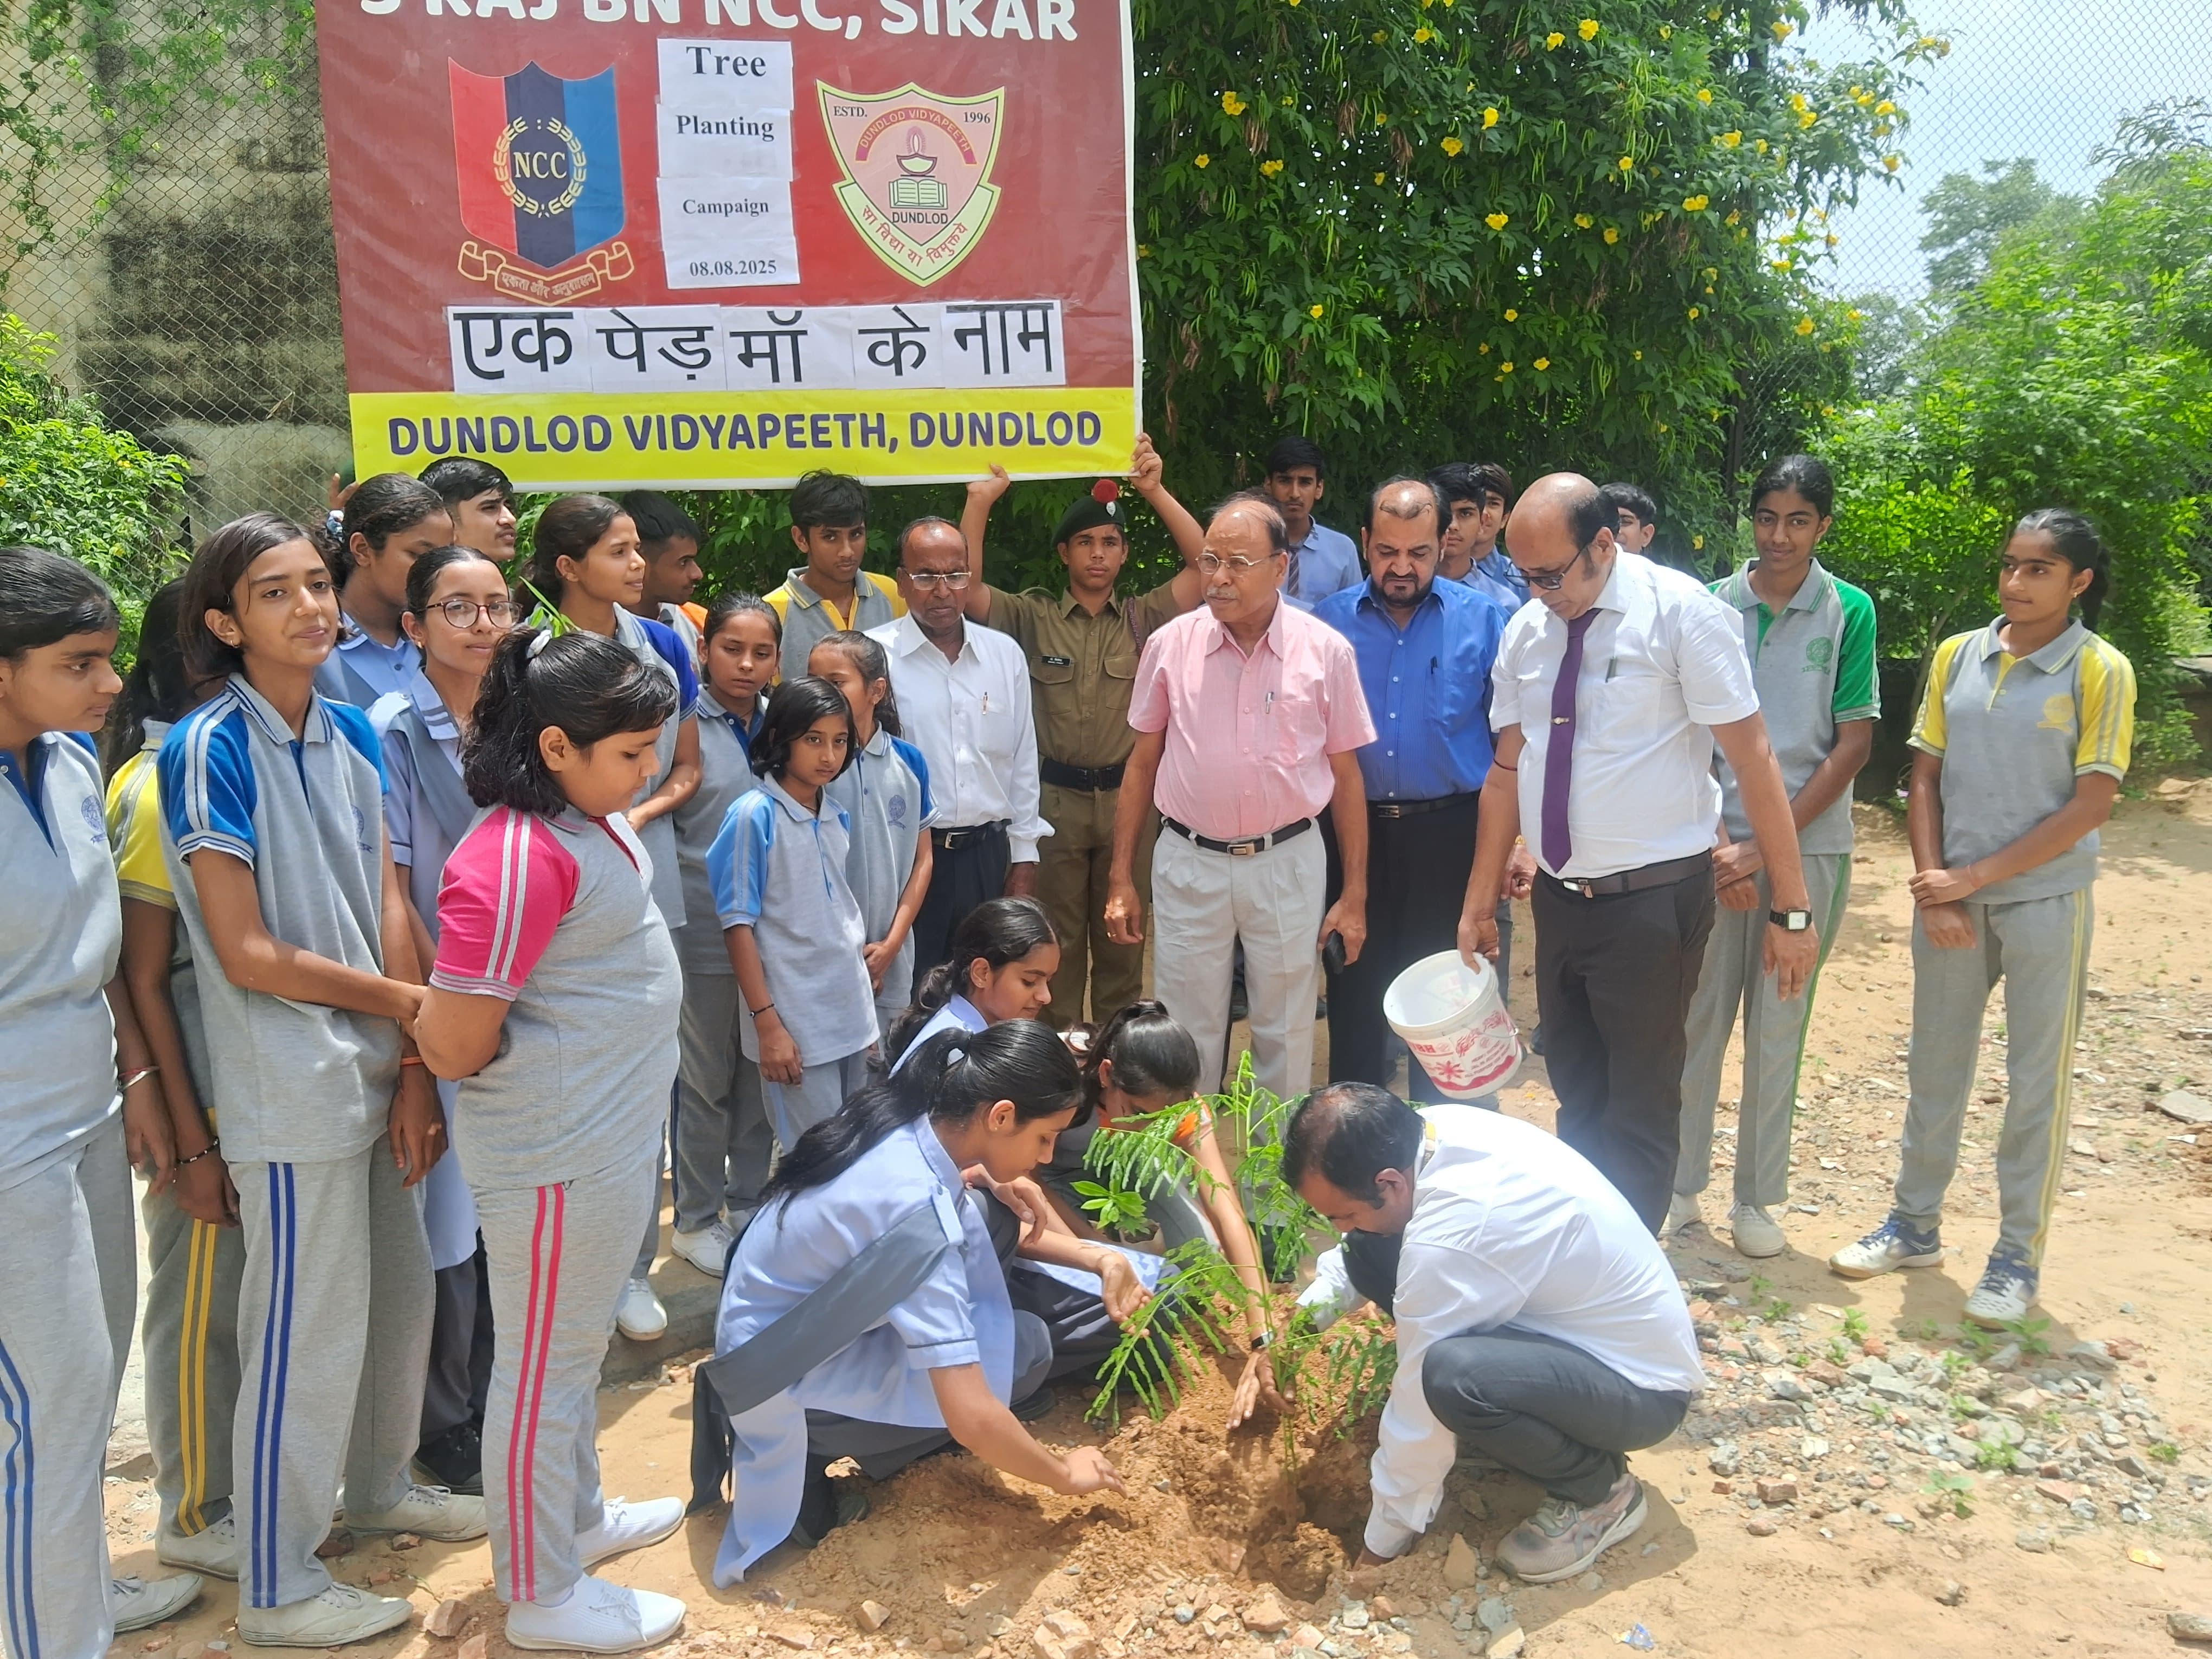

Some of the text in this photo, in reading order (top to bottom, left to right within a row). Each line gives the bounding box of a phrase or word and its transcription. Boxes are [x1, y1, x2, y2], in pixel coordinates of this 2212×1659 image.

[880, 0, 1078, 41] SIKAR
[686, 46, 767, 77] Tree
[676, 114, 774, 142] Planting
[833, 106, 991, 124] ESTD. 1996
[859, 110, 970, 152] DUNDLOD VIDYAPEETH
[513, 151, 567, 180] NCC
[683, 198, 769, 217] Campaign
[892, 211, 948, 224] DUNDLOD
[863, 205, 878, 226] सा
[906, 248, 923, 267] या
[690, 260, 777, 276] 08.08.2025
[453, 312, 574, 380] एक
[596, 308, 714, 381] पेड़
[858, 304, 930, 377] के
[946, 301, 1055, 375] नाम
[388, 410, 1102, 455] DUNDLOD VIDYAPEETH, DUNDLOD
